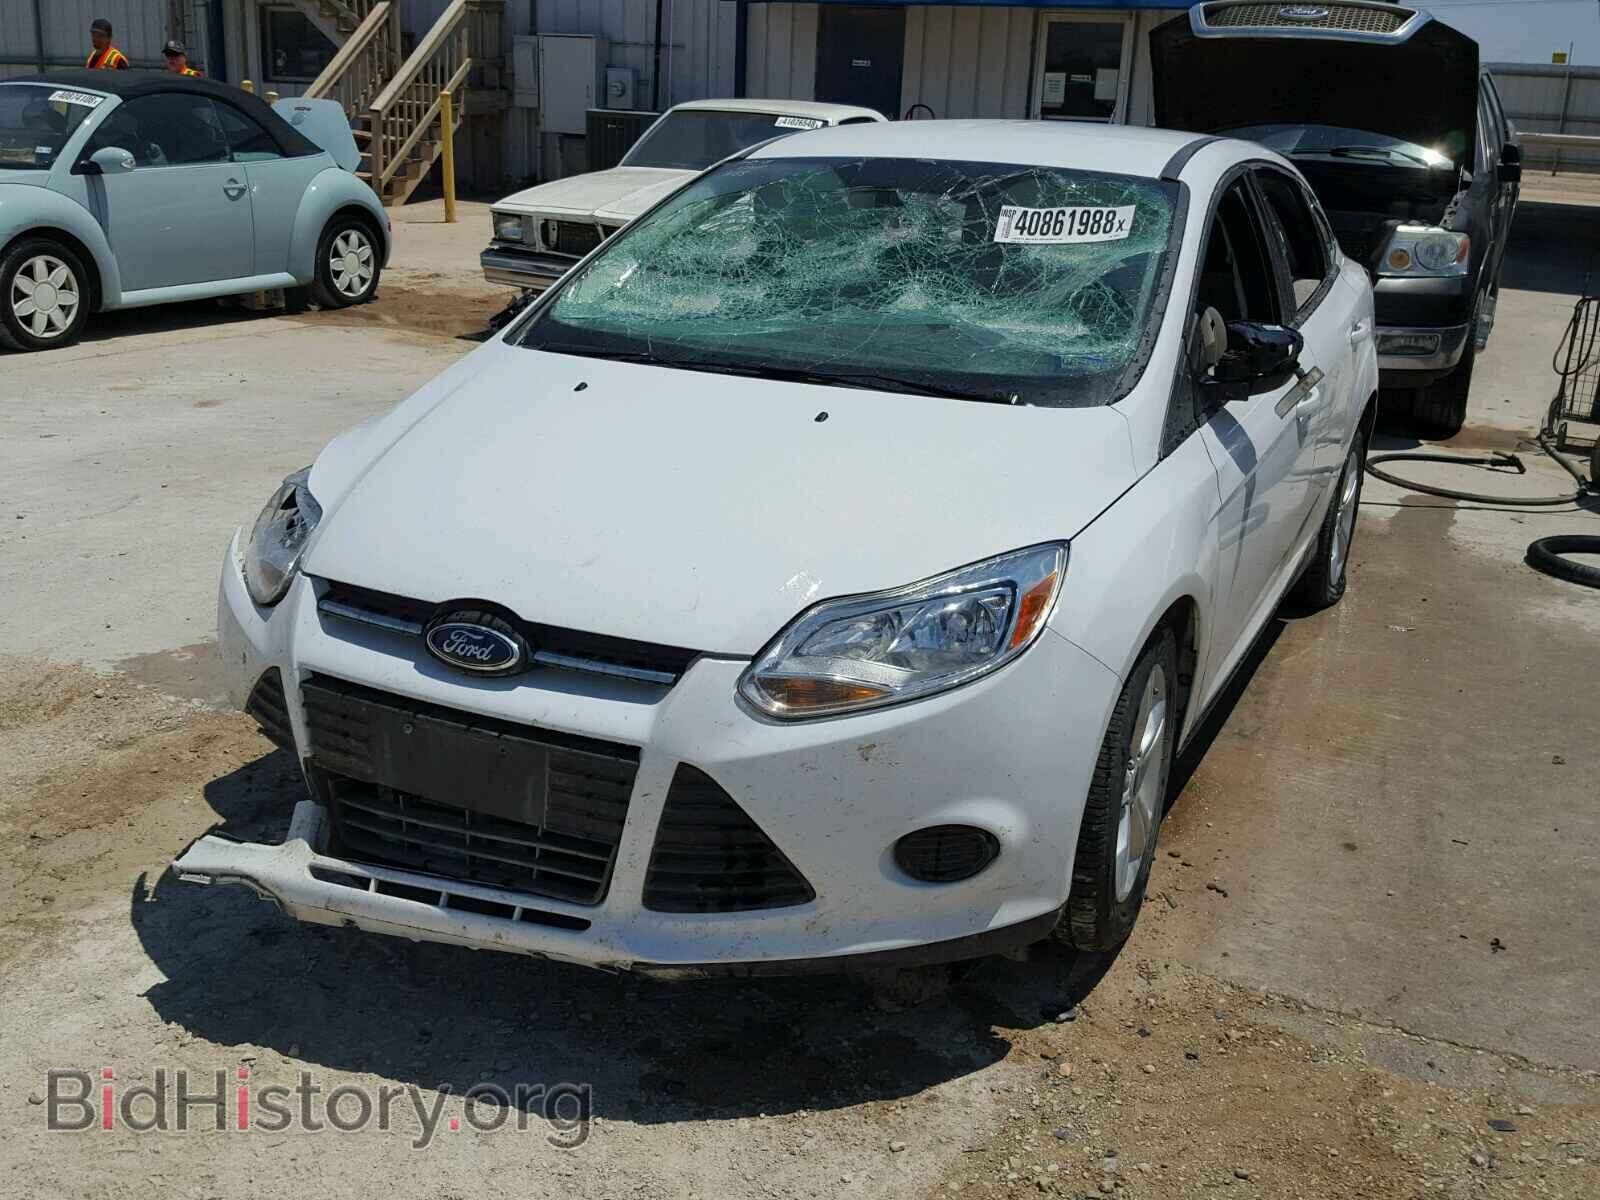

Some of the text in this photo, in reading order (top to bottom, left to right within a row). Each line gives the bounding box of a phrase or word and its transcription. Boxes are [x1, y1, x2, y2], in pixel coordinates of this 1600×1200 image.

[1000, 208, 1017, 218] INSP
[1014, 208, 1118, 236] 40861988
[442, 630, 496, 661] Ford
